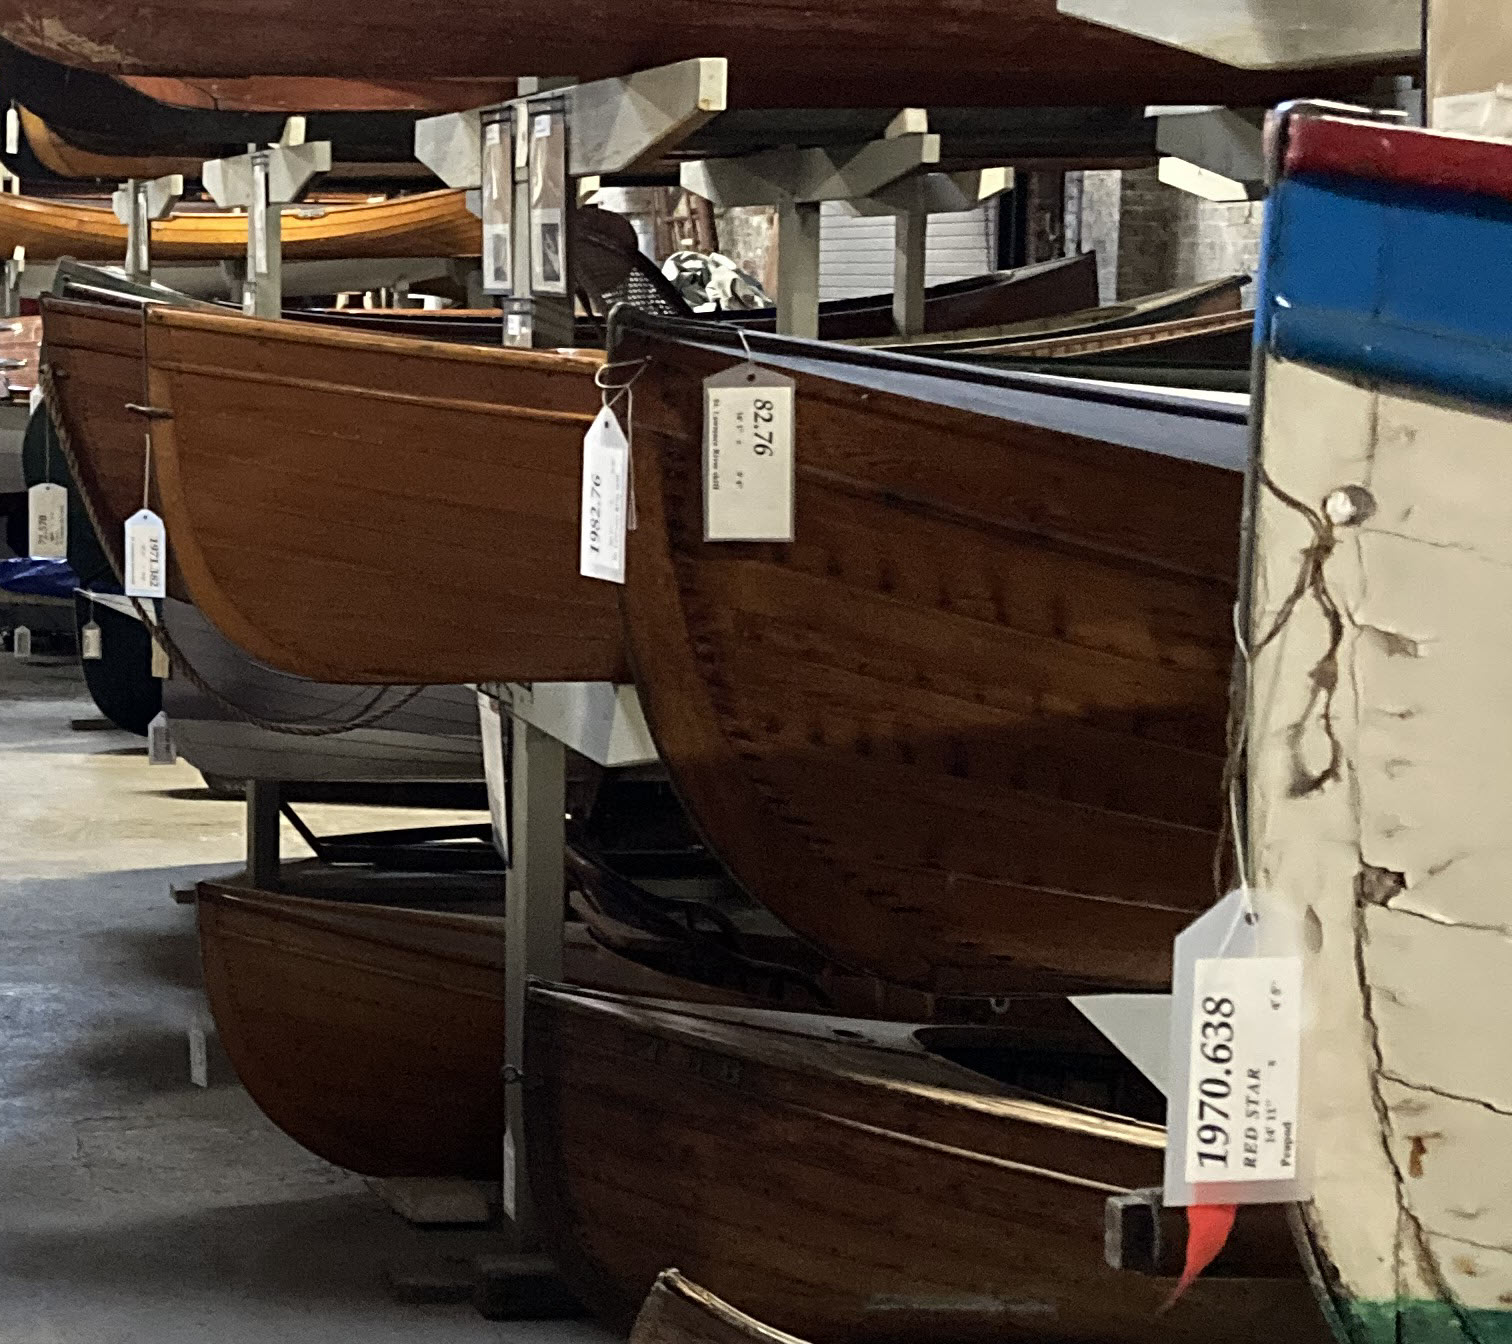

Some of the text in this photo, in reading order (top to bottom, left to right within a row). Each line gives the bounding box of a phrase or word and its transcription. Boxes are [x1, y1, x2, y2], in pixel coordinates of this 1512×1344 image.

[753, 399, 774, 457] 82.76
[589, 473, 602, 554] 1982.76
[1195, 995, 1236, 1169] 1970.638
[1243, 1067, 1262, 1169] RED STAR
